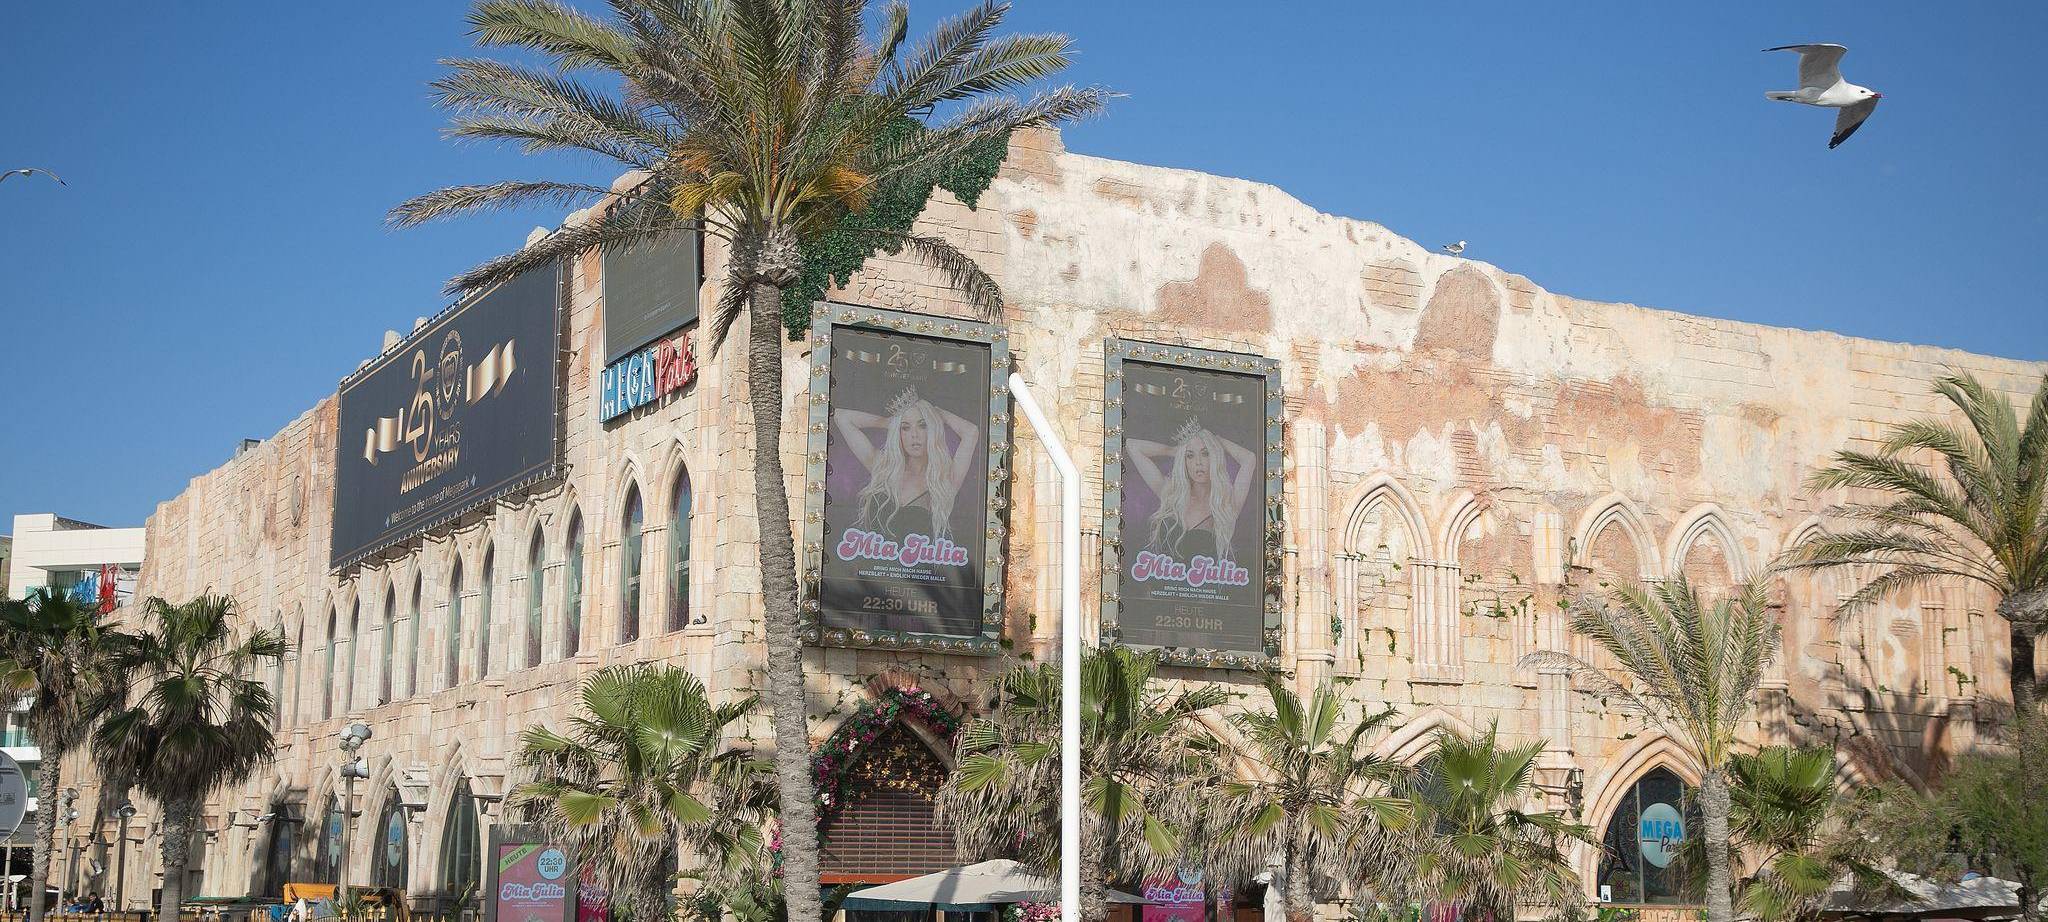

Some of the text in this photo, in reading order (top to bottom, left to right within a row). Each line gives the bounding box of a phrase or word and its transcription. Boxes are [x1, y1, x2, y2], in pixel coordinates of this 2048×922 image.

[601, 334, 695, 422] MEGA Park
[405, 349, 434, 463] 25
[400, 447, 460, 495] ANNIVERSARY
[837, 528, 968, 567] Mia Julia
[1131, 551, 1250, 587] Mia Julia
[885, 586, 917, 599] HEUTE
[863, 596, 938, 614] 22:30 UHR
[1175, 605, 1204, 616] HEUTE
[1155, 615, 1223, 631] 22:30 UHR
[1642, 820, 1683, 839] MEGA
[505, 847, 528, 865] HEUTE
[540, 857, 563, 866] 22:30
[501, 883, 532, 900] Mia
[531, 883, 565, 900] Julia
